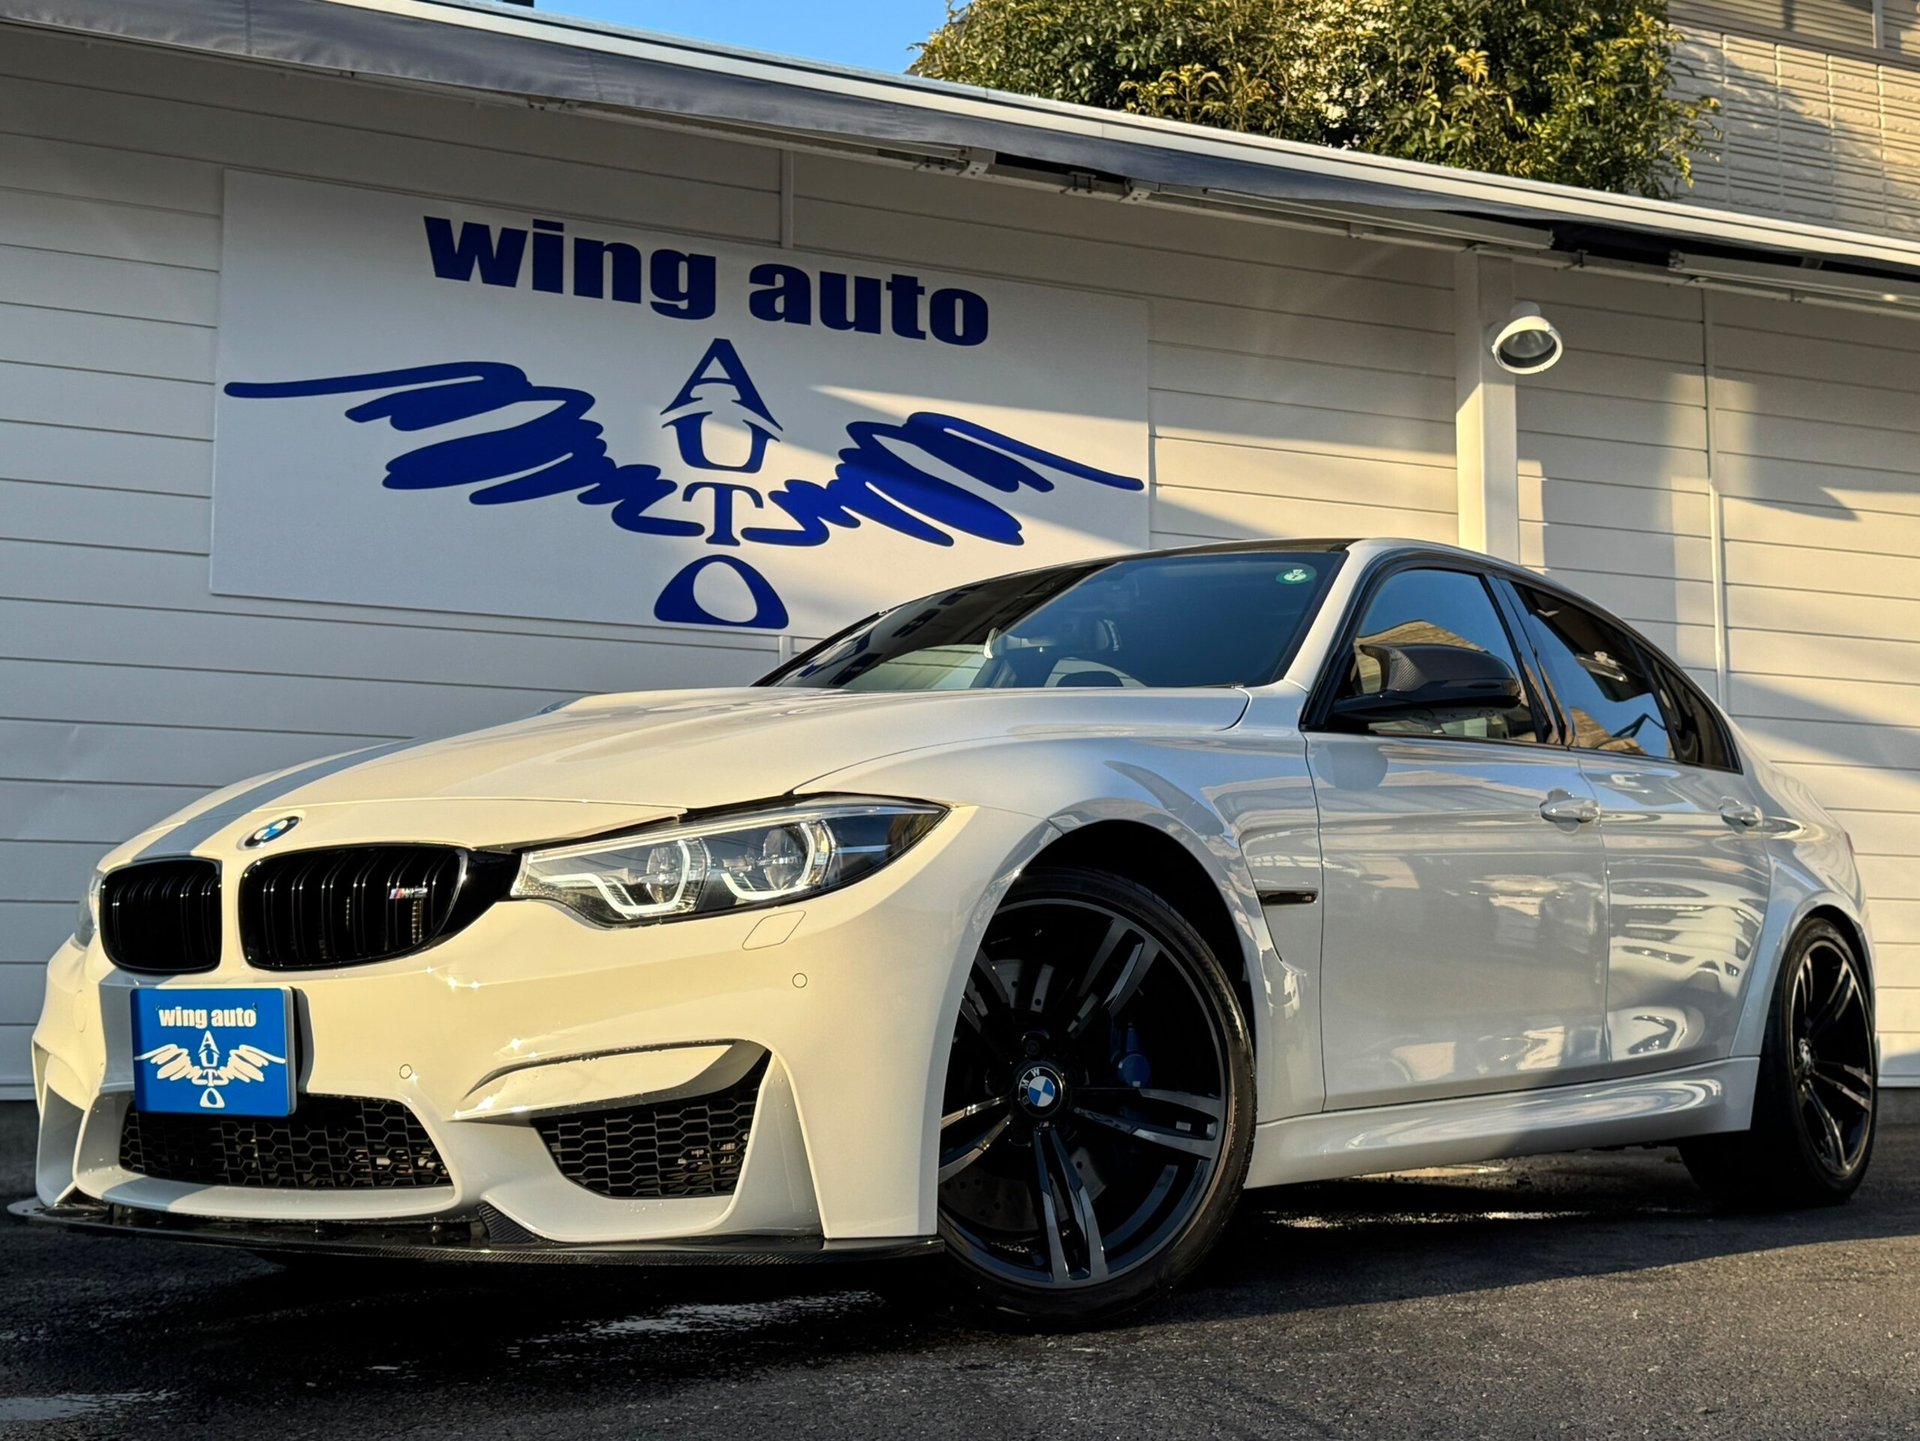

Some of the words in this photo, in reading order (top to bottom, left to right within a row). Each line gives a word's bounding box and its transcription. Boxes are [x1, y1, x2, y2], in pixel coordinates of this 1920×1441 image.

[424, 216, 717, 320] wing
[749, 263, 989, 347] auto
[654, 338, 788, 629] AUTO
[159, 1006, 208, 1030] wing
[211, 1007, 257, 1029] auto
